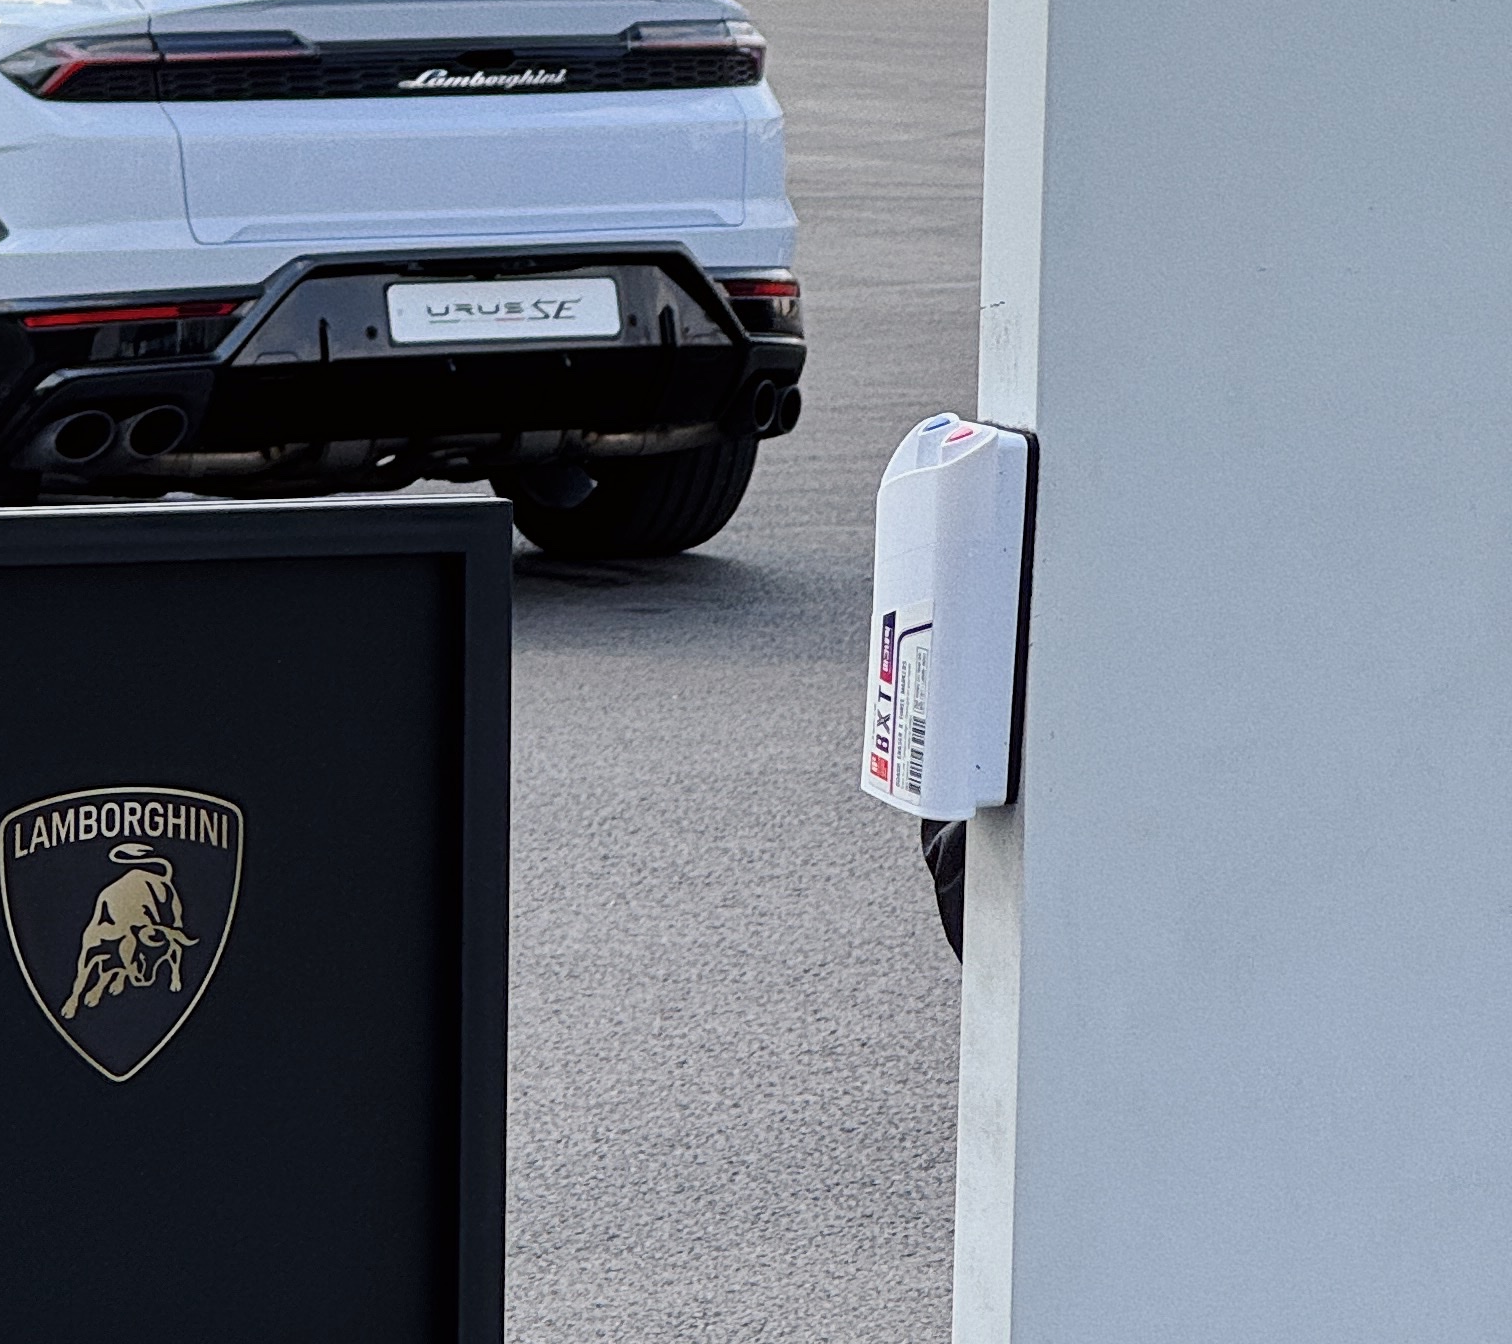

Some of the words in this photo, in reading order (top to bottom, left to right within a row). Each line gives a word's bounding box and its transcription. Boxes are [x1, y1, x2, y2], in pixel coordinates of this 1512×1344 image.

[397, 67, 567, 90] Lamborghini
[425, 300, 525, 318] URUS
[527, 297, 583, 321] SE
[14, 801, 229, 860] LAMBORGHINI
